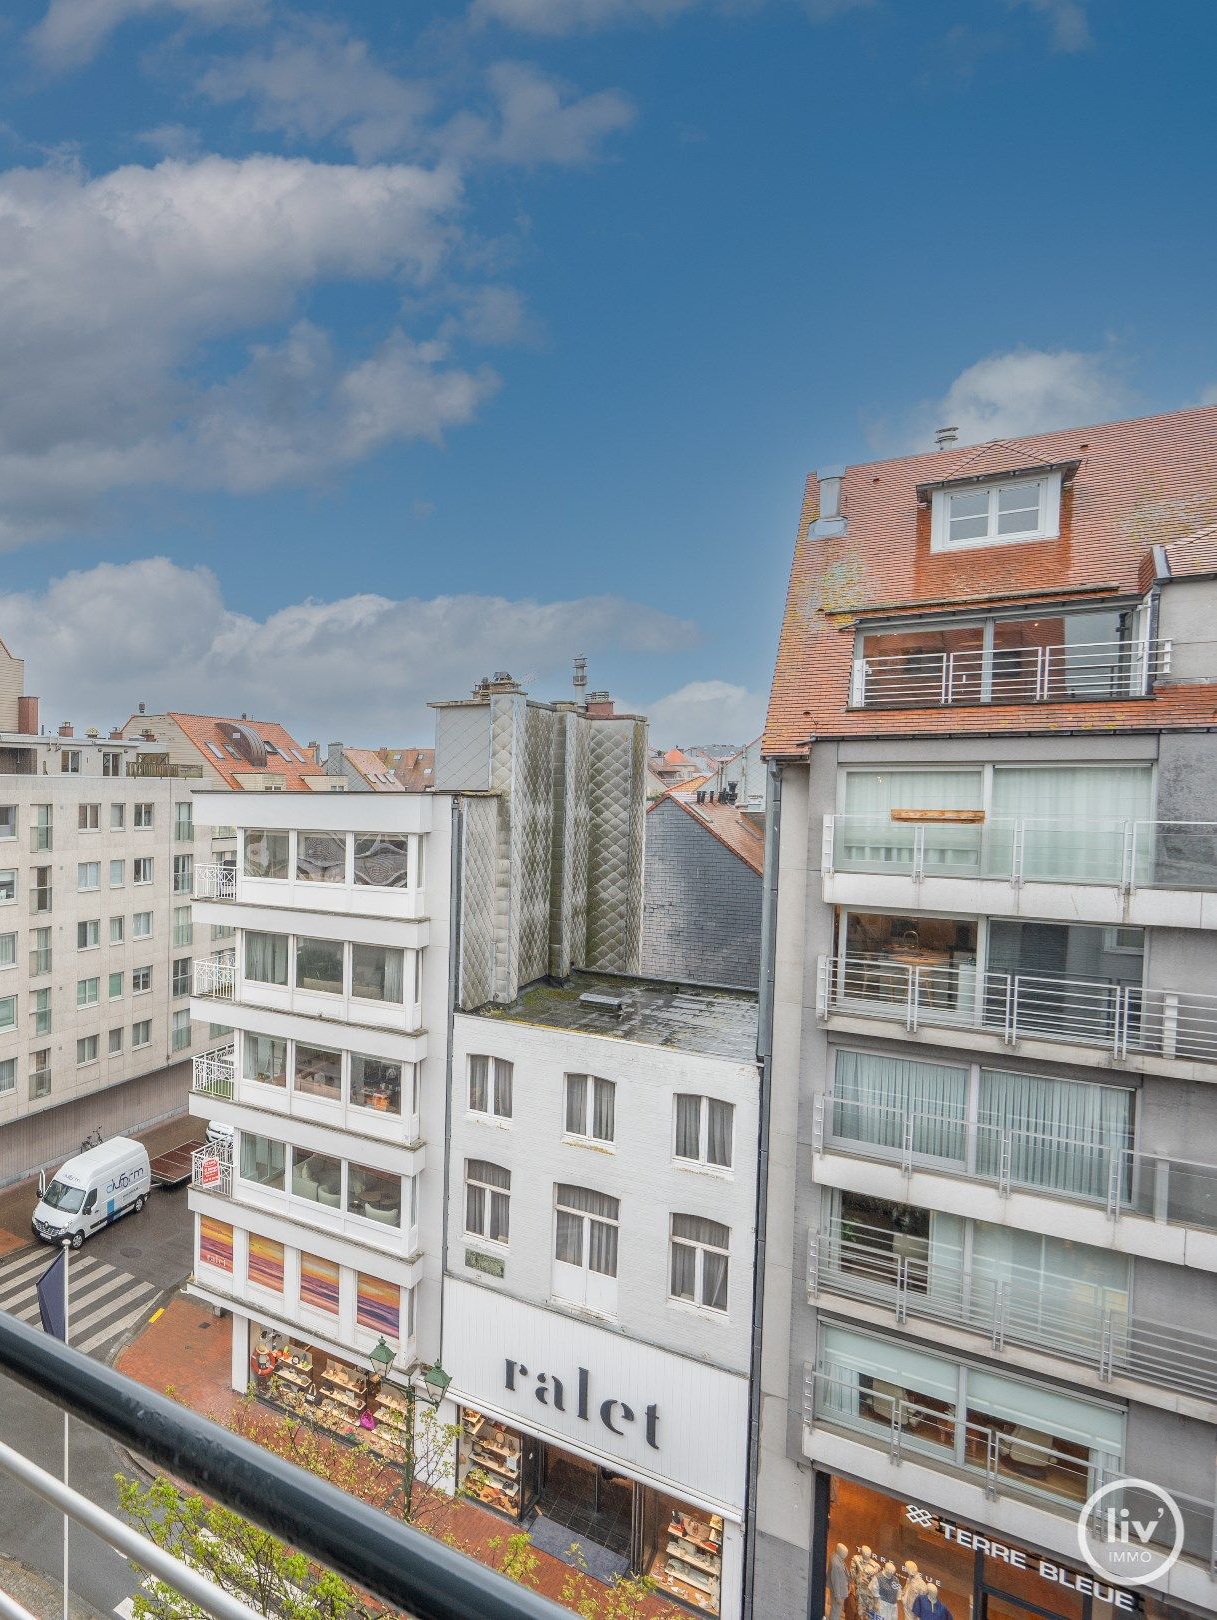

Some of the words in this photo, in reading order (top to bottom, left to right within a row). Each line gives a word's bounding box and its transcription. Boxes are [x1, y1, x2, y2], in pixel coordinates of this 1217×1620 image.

[504, 1358, 660, 1450] ralet
[940, 1521, 1027, 1570] TERRE
[1039, 1560, 1134, 1612] BLEUE
